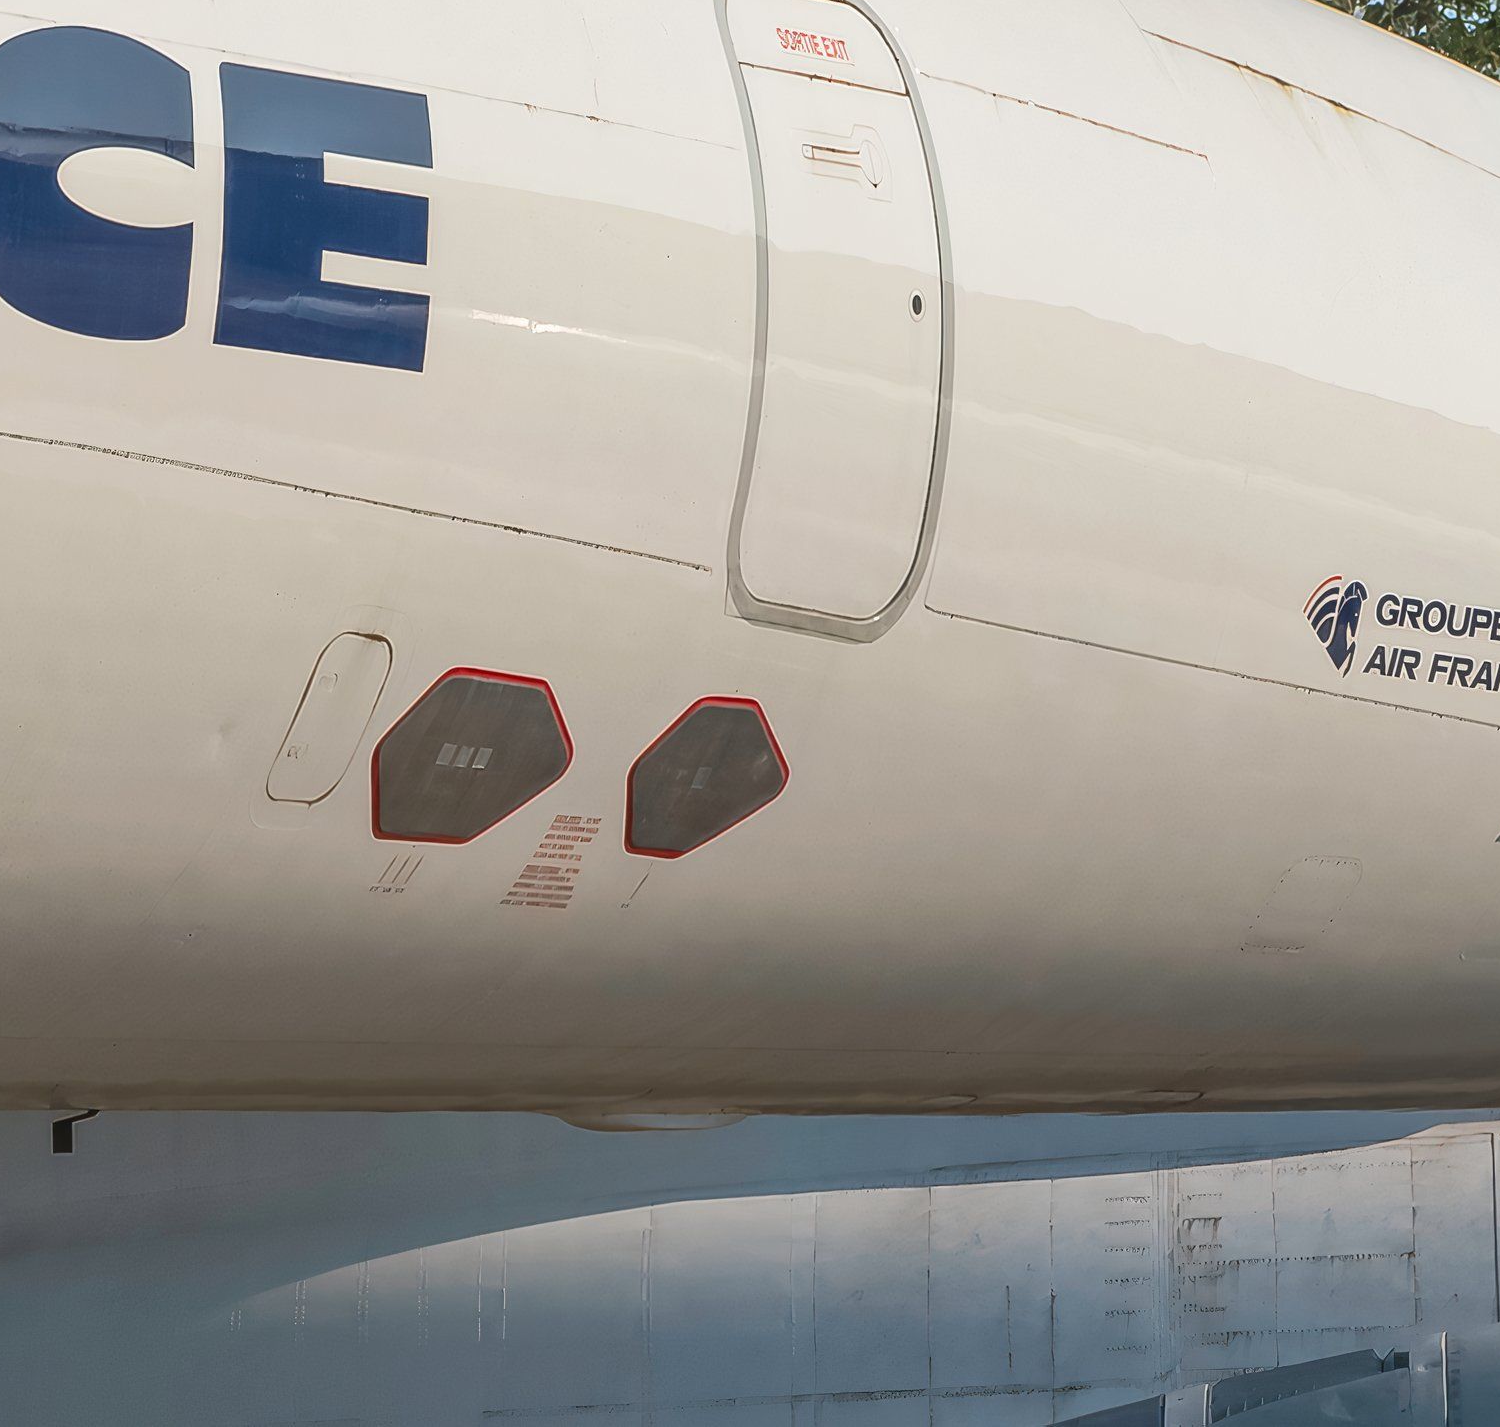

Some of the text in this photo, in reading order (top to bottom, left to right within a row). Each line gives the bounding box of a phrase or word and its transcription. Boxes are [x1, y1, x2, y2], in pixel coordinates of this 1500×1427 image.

[776, 27, 850, 61] SORTIE EXIT
[1362, 645, 1421, 681] AIR
